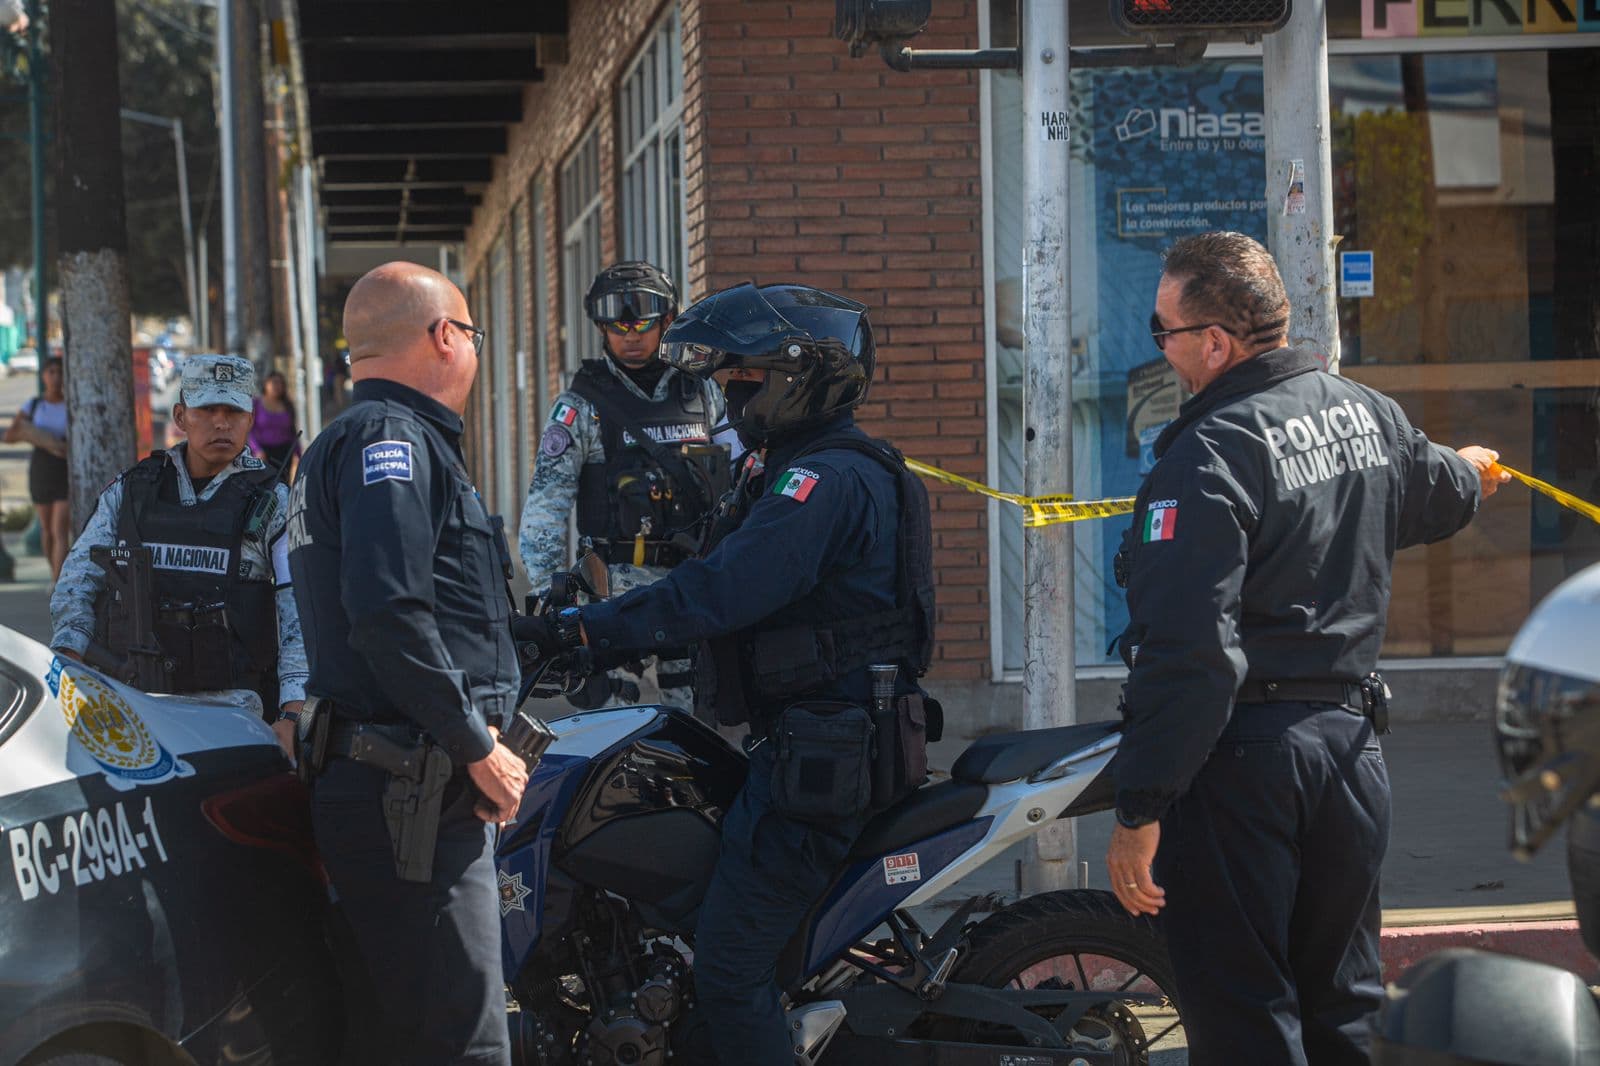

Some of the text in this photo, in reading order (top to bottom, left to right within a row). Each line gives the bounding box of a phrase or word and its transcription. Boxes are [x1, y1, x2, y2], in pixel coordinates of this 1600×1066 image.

[1160, 138, 1194, 151] Entre
[1213, 140, 1220, 153] y
[1223, 138, 1235, 150] tu
[1125, 200, 1268, 214] Los mejores productos par
[1126, 217, 1135, 229] la
[664, 423, 706, 440] NACIONAL
[164, 546, 226, 571] NACIONAL
[9, 796, 169, 901] BC-299A-1
[888, 856, 913, 867] 911
